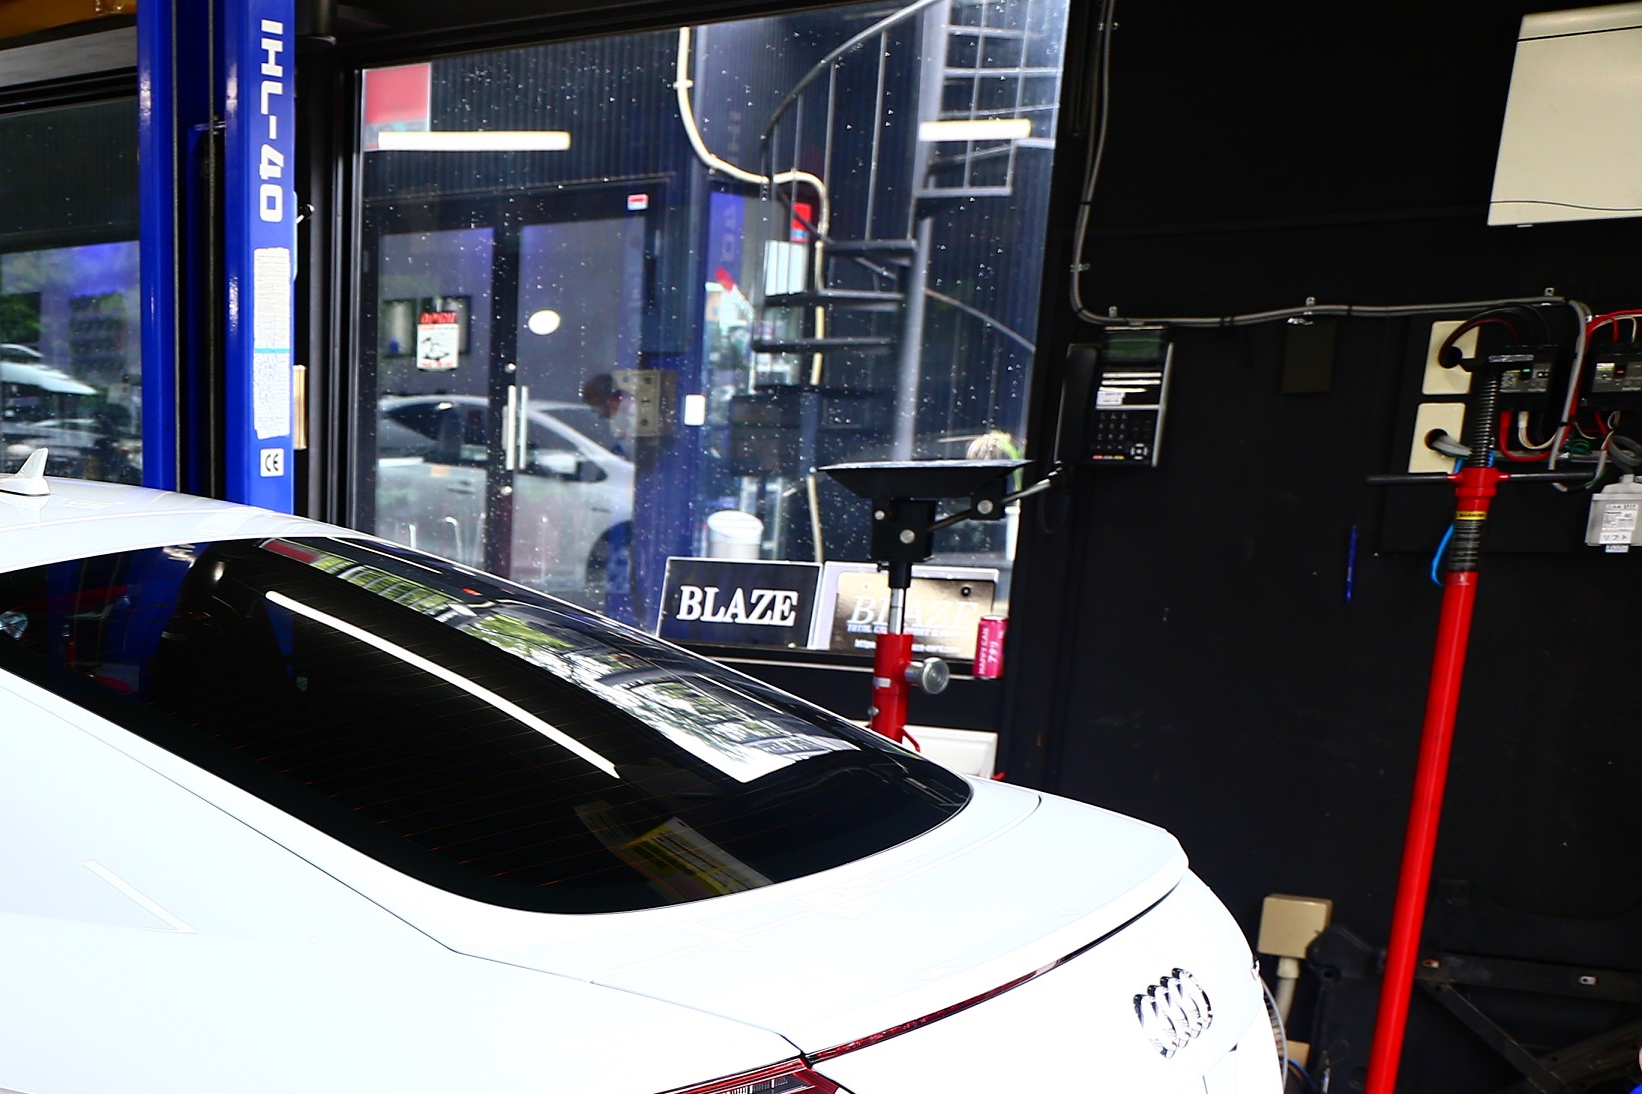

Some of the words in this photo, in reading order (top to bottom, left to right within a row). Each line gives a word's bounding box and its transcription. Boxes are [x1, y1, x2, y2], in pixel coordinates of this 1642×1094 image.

[259, 19, 284, 223] IHL-40
[264, 453, 279, 472] CE
[675, 585, 799, 627] BLAZE
